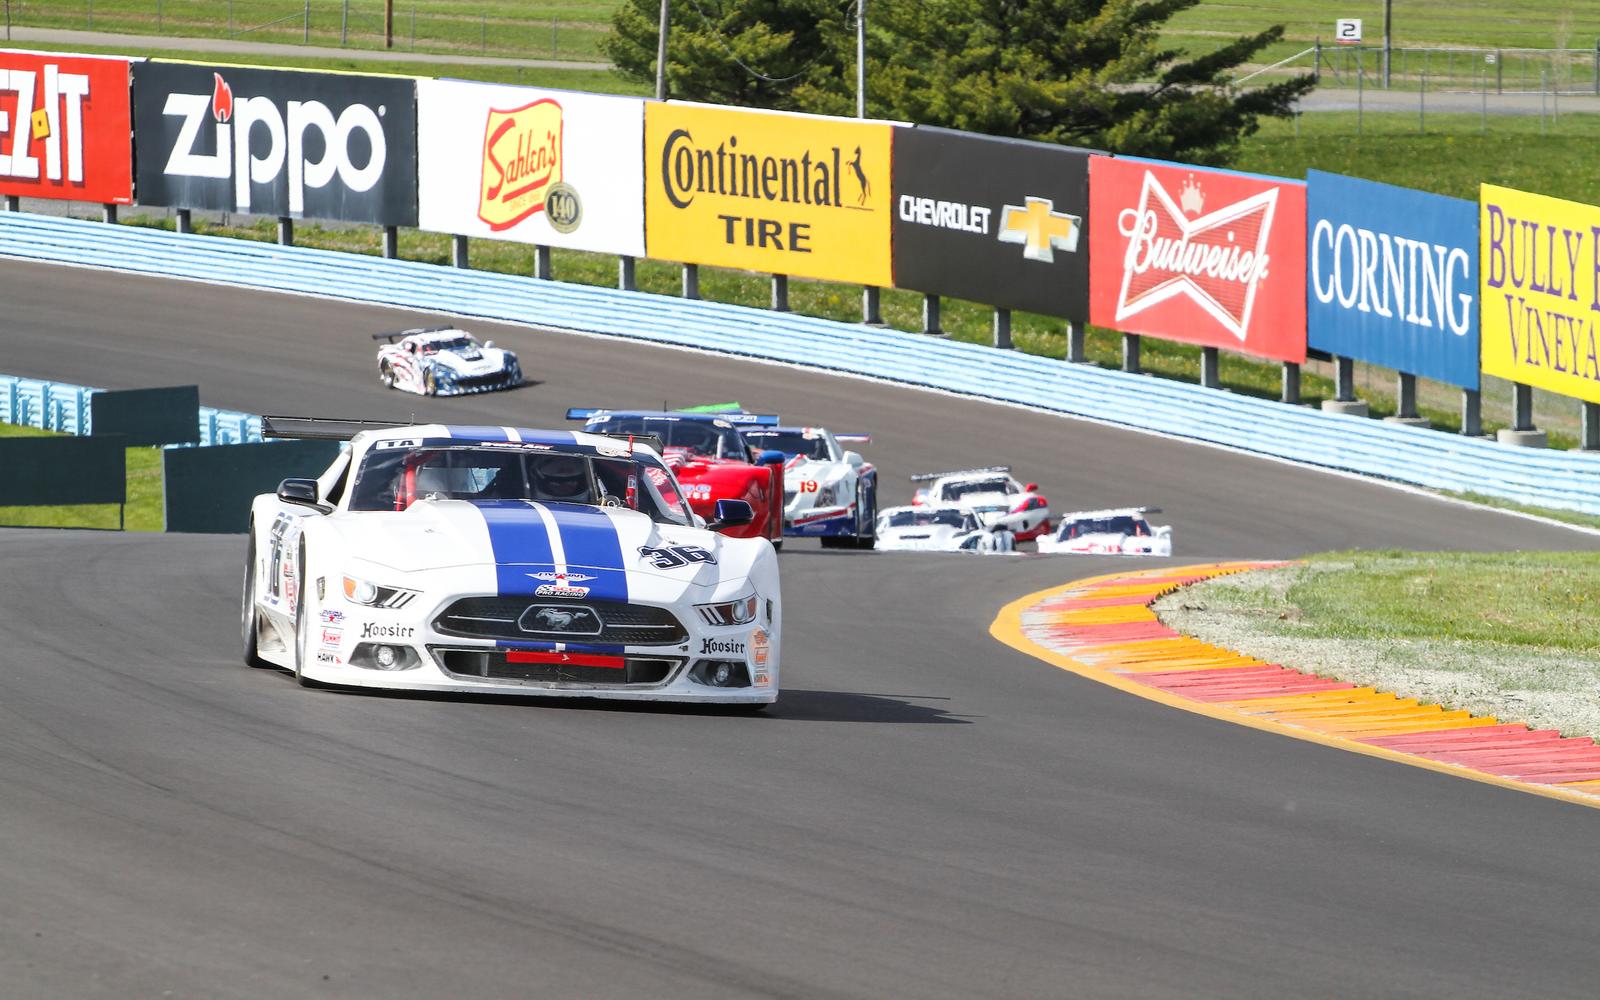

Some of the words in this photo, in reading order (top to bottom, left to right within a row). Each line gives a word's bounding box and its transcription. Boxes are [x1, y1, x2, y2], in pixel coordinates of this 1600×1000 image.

[1341, 23, 1356, 37] 2
[162, 92, 387, 214] Zippo
[486, 116, 558, 201] Sahlen's
[661, 128, 843, 209] Continental
[552, 195, 576, 220] 140
[899, 194, 992, 235] CHEVROLET
[717, 214, 812, 253] TIRE
[1117, 207, 1270, 284] Budweiser
[1486, 203, 1583, 301] BULLY
[1311, 218, 1473, 337] CORNING
[799, 479, 819, 493] 19
[636, 545, 718, 571] 36
[360, 622, 415, 639] Hoosier
[699, 637, 746, 655] Hoosier
